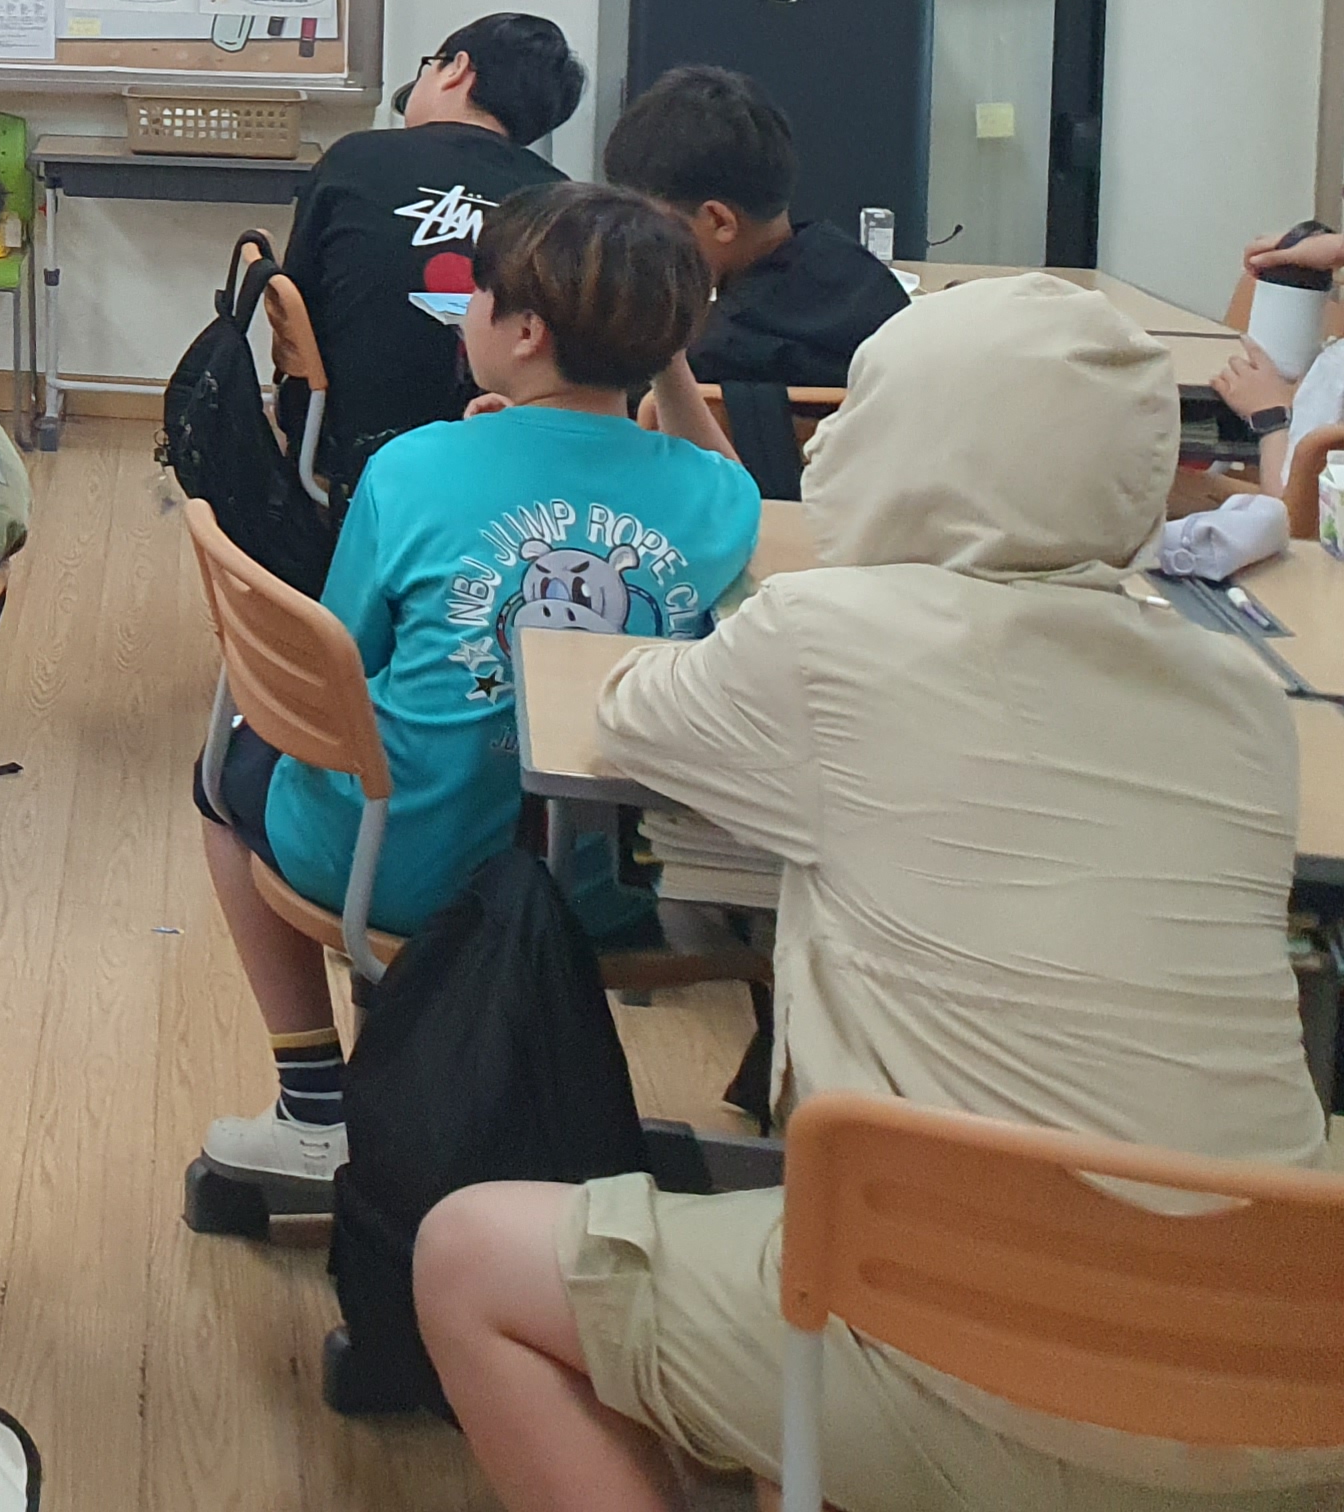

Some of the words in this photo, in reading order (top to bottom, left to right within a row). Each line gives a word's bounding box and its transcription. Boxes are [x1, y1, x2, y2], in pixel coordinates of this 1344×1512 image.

[445, 555, 502, 626] NBJ
[480, 498, 576, 567] JUMP
[587, 503, 688, 586] ROPE
[665, 583, 700, 639] CL
